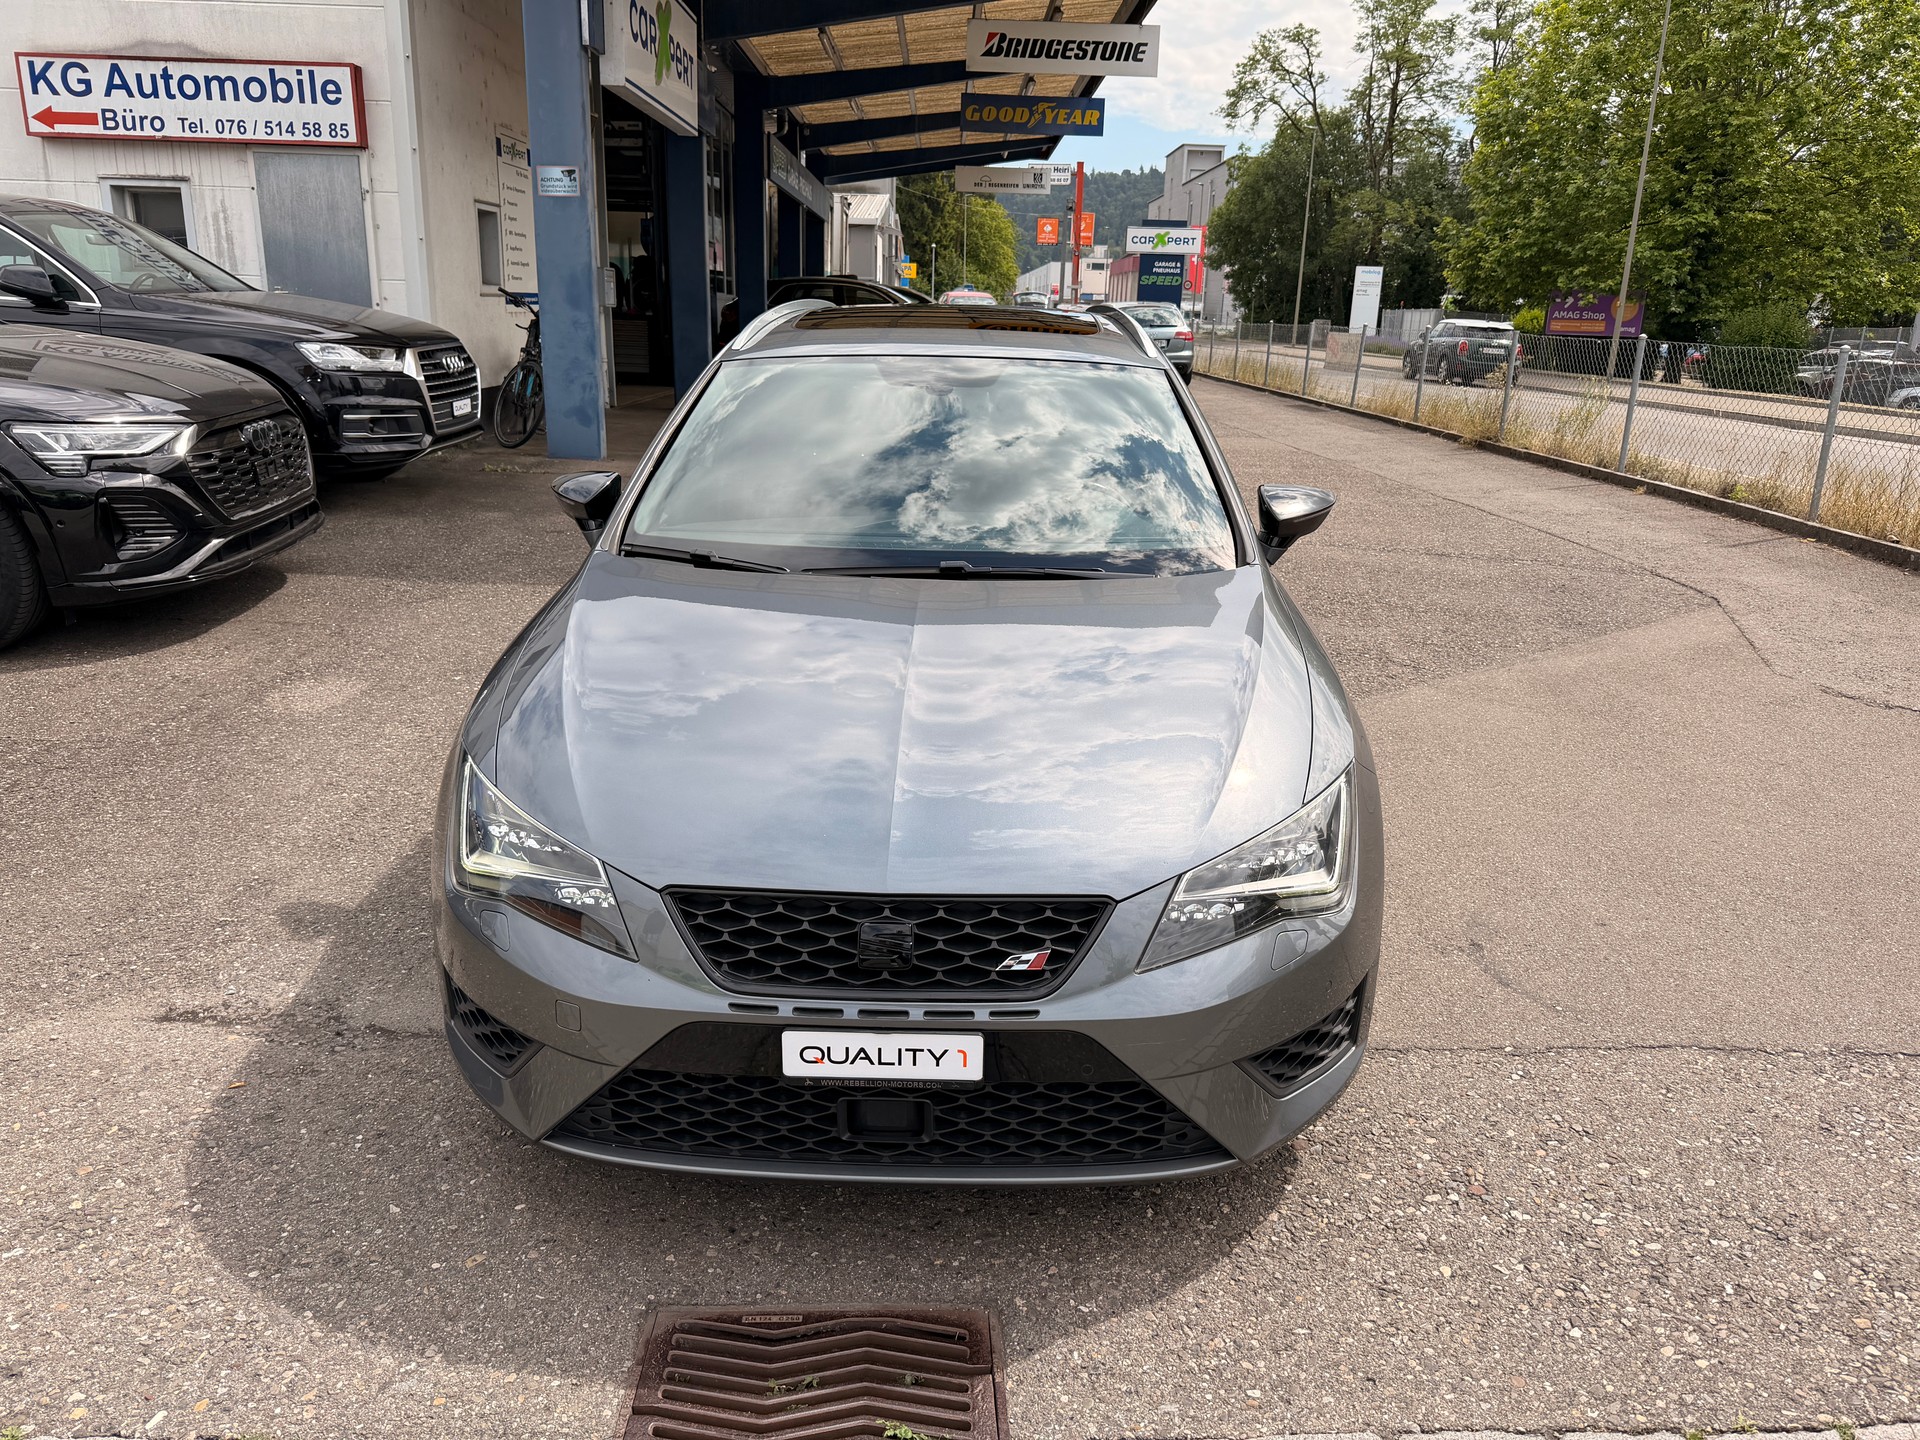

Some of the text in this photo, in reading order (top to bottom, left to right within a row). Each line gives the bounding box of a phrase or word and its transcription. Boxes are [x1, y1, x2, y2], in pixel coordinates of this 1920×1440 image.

[980, 32, 1148, 62] BRIDGESTONE
[27, 60, 342, 105] KG Automobile
[101, 108, 349, 139] Büro Tel. 076 / 514 58 85
[1140, 275, 1182, 286] SPEED
[1552, 310, 1606, 321] AMAG Shop
[799, 1046, 968, 1068] QUALITY 1
